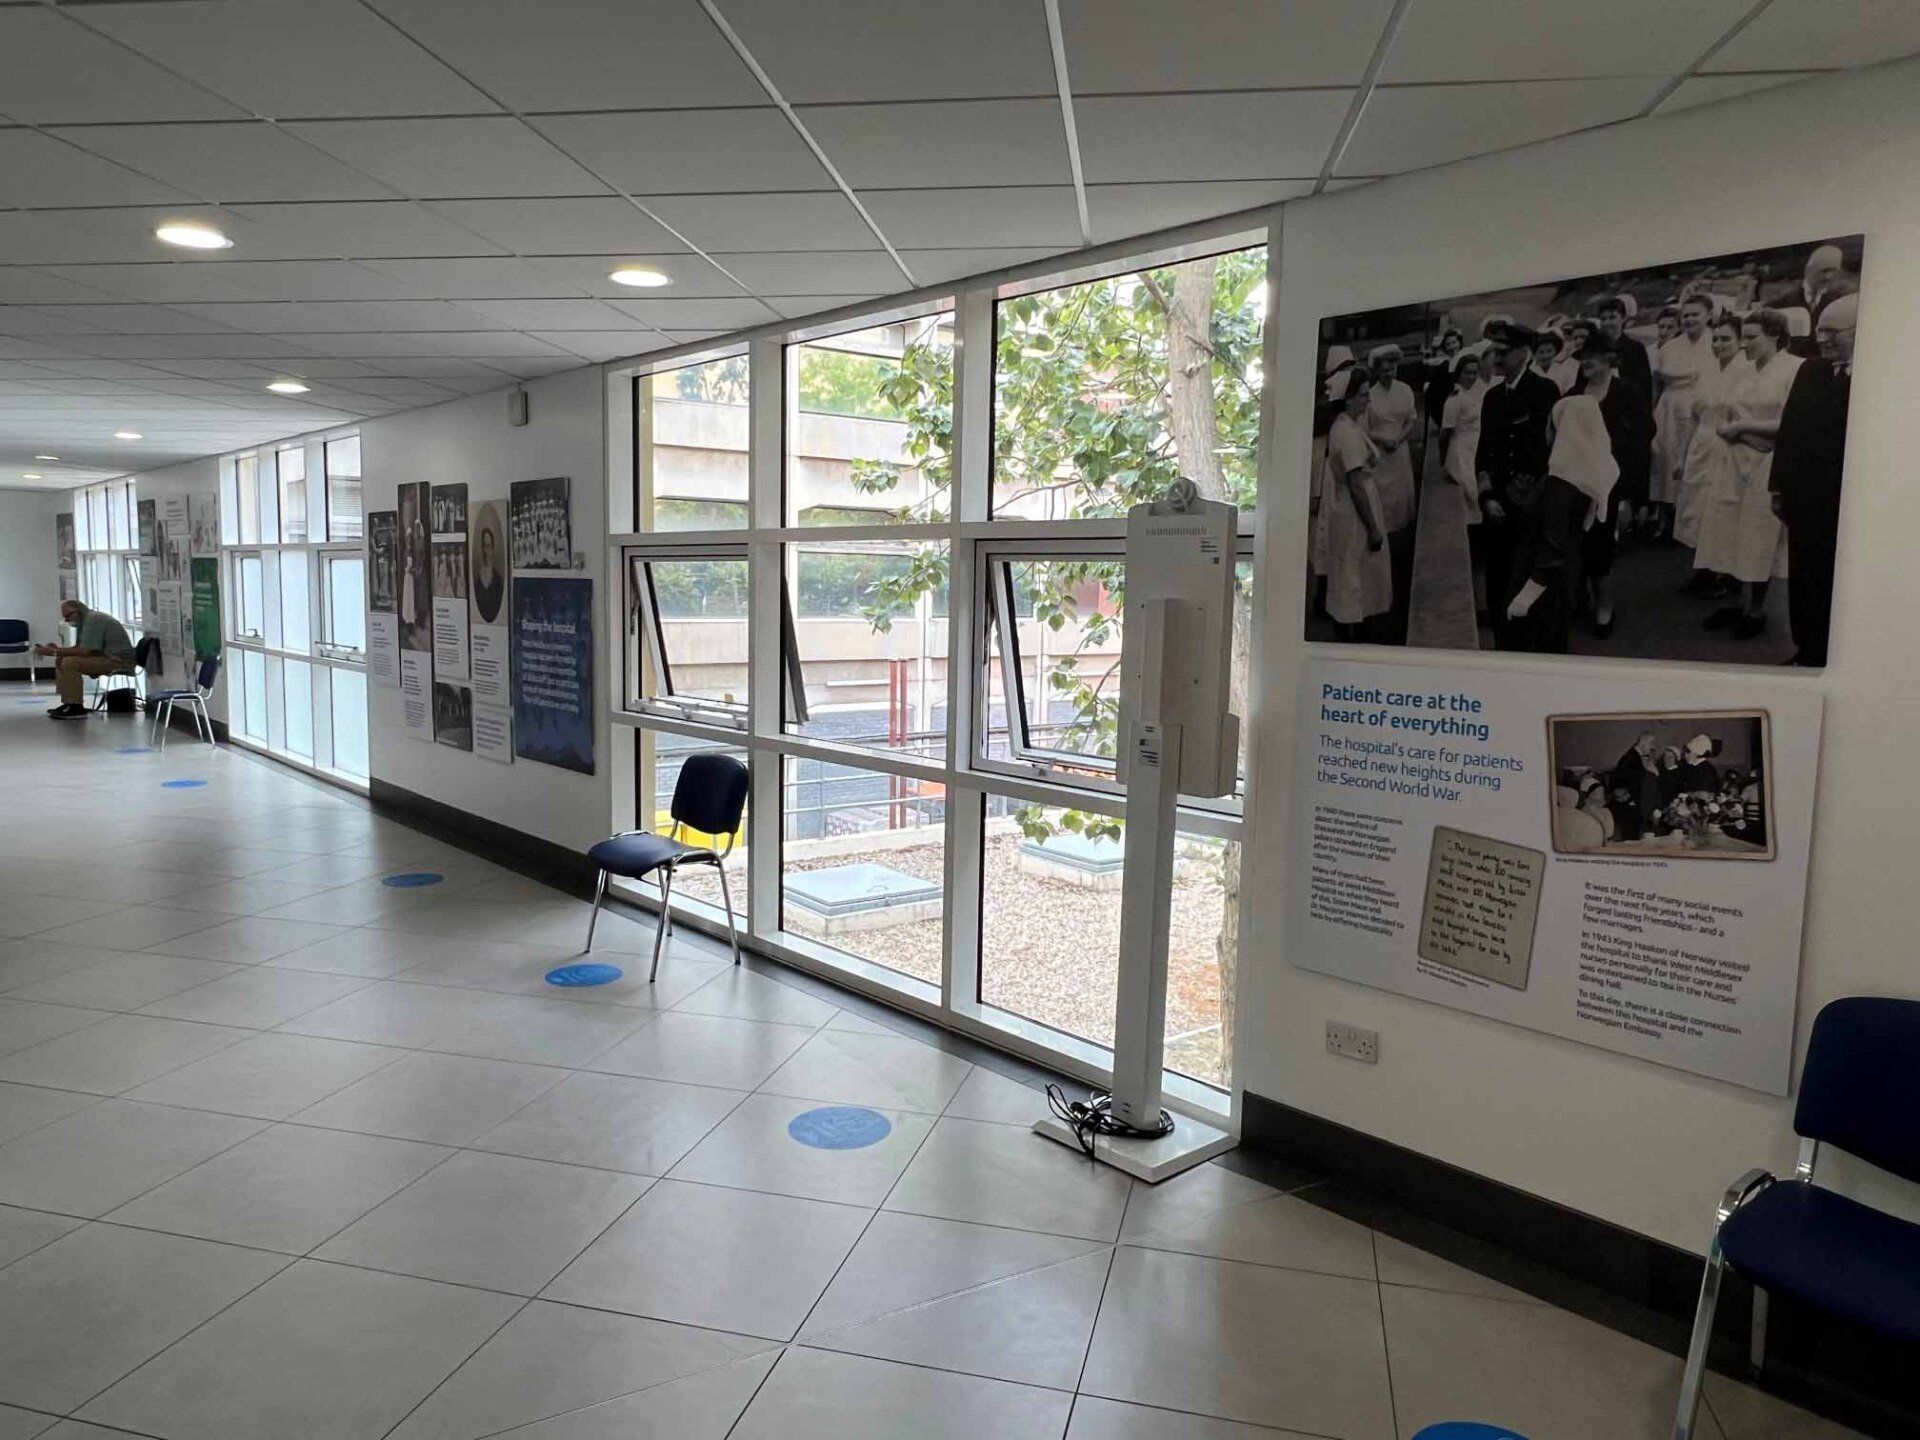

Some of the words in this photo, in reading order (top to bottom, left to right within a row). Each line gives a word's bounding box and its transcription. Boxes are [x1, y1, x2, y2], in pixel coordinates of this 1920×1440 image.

[1323, 684, 1386, 704] Patient
[1387, 692, 1422, 708] care
[1427, 696, 1445, 710] at
[1450, 694, 1481, 713] the
[1321, 705, 1364, 725] heart
[1369, 711, 1387, 726] of
[1391, 717, 1489, 740] everything
[1320, 734, 1342, 749] The
[1345, 736, 1404, 756] hospital's
[1407, 747, 1435, 761] care
[1440, 748, 1460, 763] for
[1463, 753, 1524, 771] patients
[1317, 770, 1338, 783] the
[1340, 773, 1386, 791] Second
[1389, 780, 1429, 797] World
[1432, 786, 1463, 801] War.
[1319, 754, 1367, 770] reached
[1370, 760, 1399, 773] new
[1401, 762, 1451, 784] heights
[1454, 771, 1501, 791] during
[1312, 866, 1329, 875] Many
[1584, 893, 1602, 902] over
[1604, 896, 1619, 906] the
[1620, 900, 1640, 910] next
[1641, 902, 1659, 913] five
[1660, 908, 1684, 920] years,
[1687, 912, 1715, 924] which
[1585, 882, 1591, 890] It
[1593, 884, 1609, 893] was
[1610, 885, 1626, 896] the
[1627, 887, 1645, 900] first
[1646, 893, 1656, 901] of
[1658, 896, 1683, 908] many
[1684, 899, 1710, 912] social
[1711, 905, 1744, 918] events
[1582, 913, 1599, 924] few
[1600, 919, 1644, 933] marriages.
[1583, 902, 1612, 916] forged
[1613, 910, 1642, 922] lasting
[1644, 914, 1692, 932] friendships
[1698, 926, 1718, 937] and
[1718, 930, 1725, 938] a
[1581, 941, 1595, 951] the
[1596, 944, 1630, 959] hospital
[1631, 952, 1642, 960] to
[1643, 953, 1668, 966] thank
[1669, 960, 1692, 973] West
[1694, 966, 1743, 982] Middlesex
[1582, 930, 1590, 939] In
[1592, 932, 1612, 944] 1943
[1614, 935, 1633, 949] King
[1634, 941, 1668, 955] Haakon
[1669, 948, 1679, 958] of
[1680, 950, 1717, 966] Norway
[1718, 960, 1750, 972] visited
[1578, 974, 1605, 987] dining
[1580, 952, 1608, 965] nurses
[1608, 958, 1653, 976] personally
[1654, 967, 1668, 978] for
[1669, 970, 1692, 983] their
[1692, 976, 1713, 987] care
[1714, 981, 1732, 992] and
[1580, 963, 1595, 973] was
[1596, 967, 1647, 984] entertained
[1648, 978, 1658, 986] to
[1660, 980, 1674, 991] tea
[1676, 984, 1684, 992] in
[1686, 986, 1702, 997] the
[1576, 1010, 1622, 1029] Norwegian
[1577, 999, 1614, 1016] between
[1615, 1008, 1632, 1020] this
[1632, 1012, 1668, 1030] hospital
[1668, 1022, 1686, 1033] and
[1687, 1026, 1704, 1038] the
[1578, 988, 1588, 999] To
[1590, 991, 1605, 1003] this
[1606, 995, 1624, 1008] day,
[1625, 1000, 1648, 1012] there
[1650, 1006, 1657, 1015] is
[1658, 1009, 1664, 1017] a
[1665, 1010, 1688, 1023] close
[1689, 1016, 1742, 1035] connection
